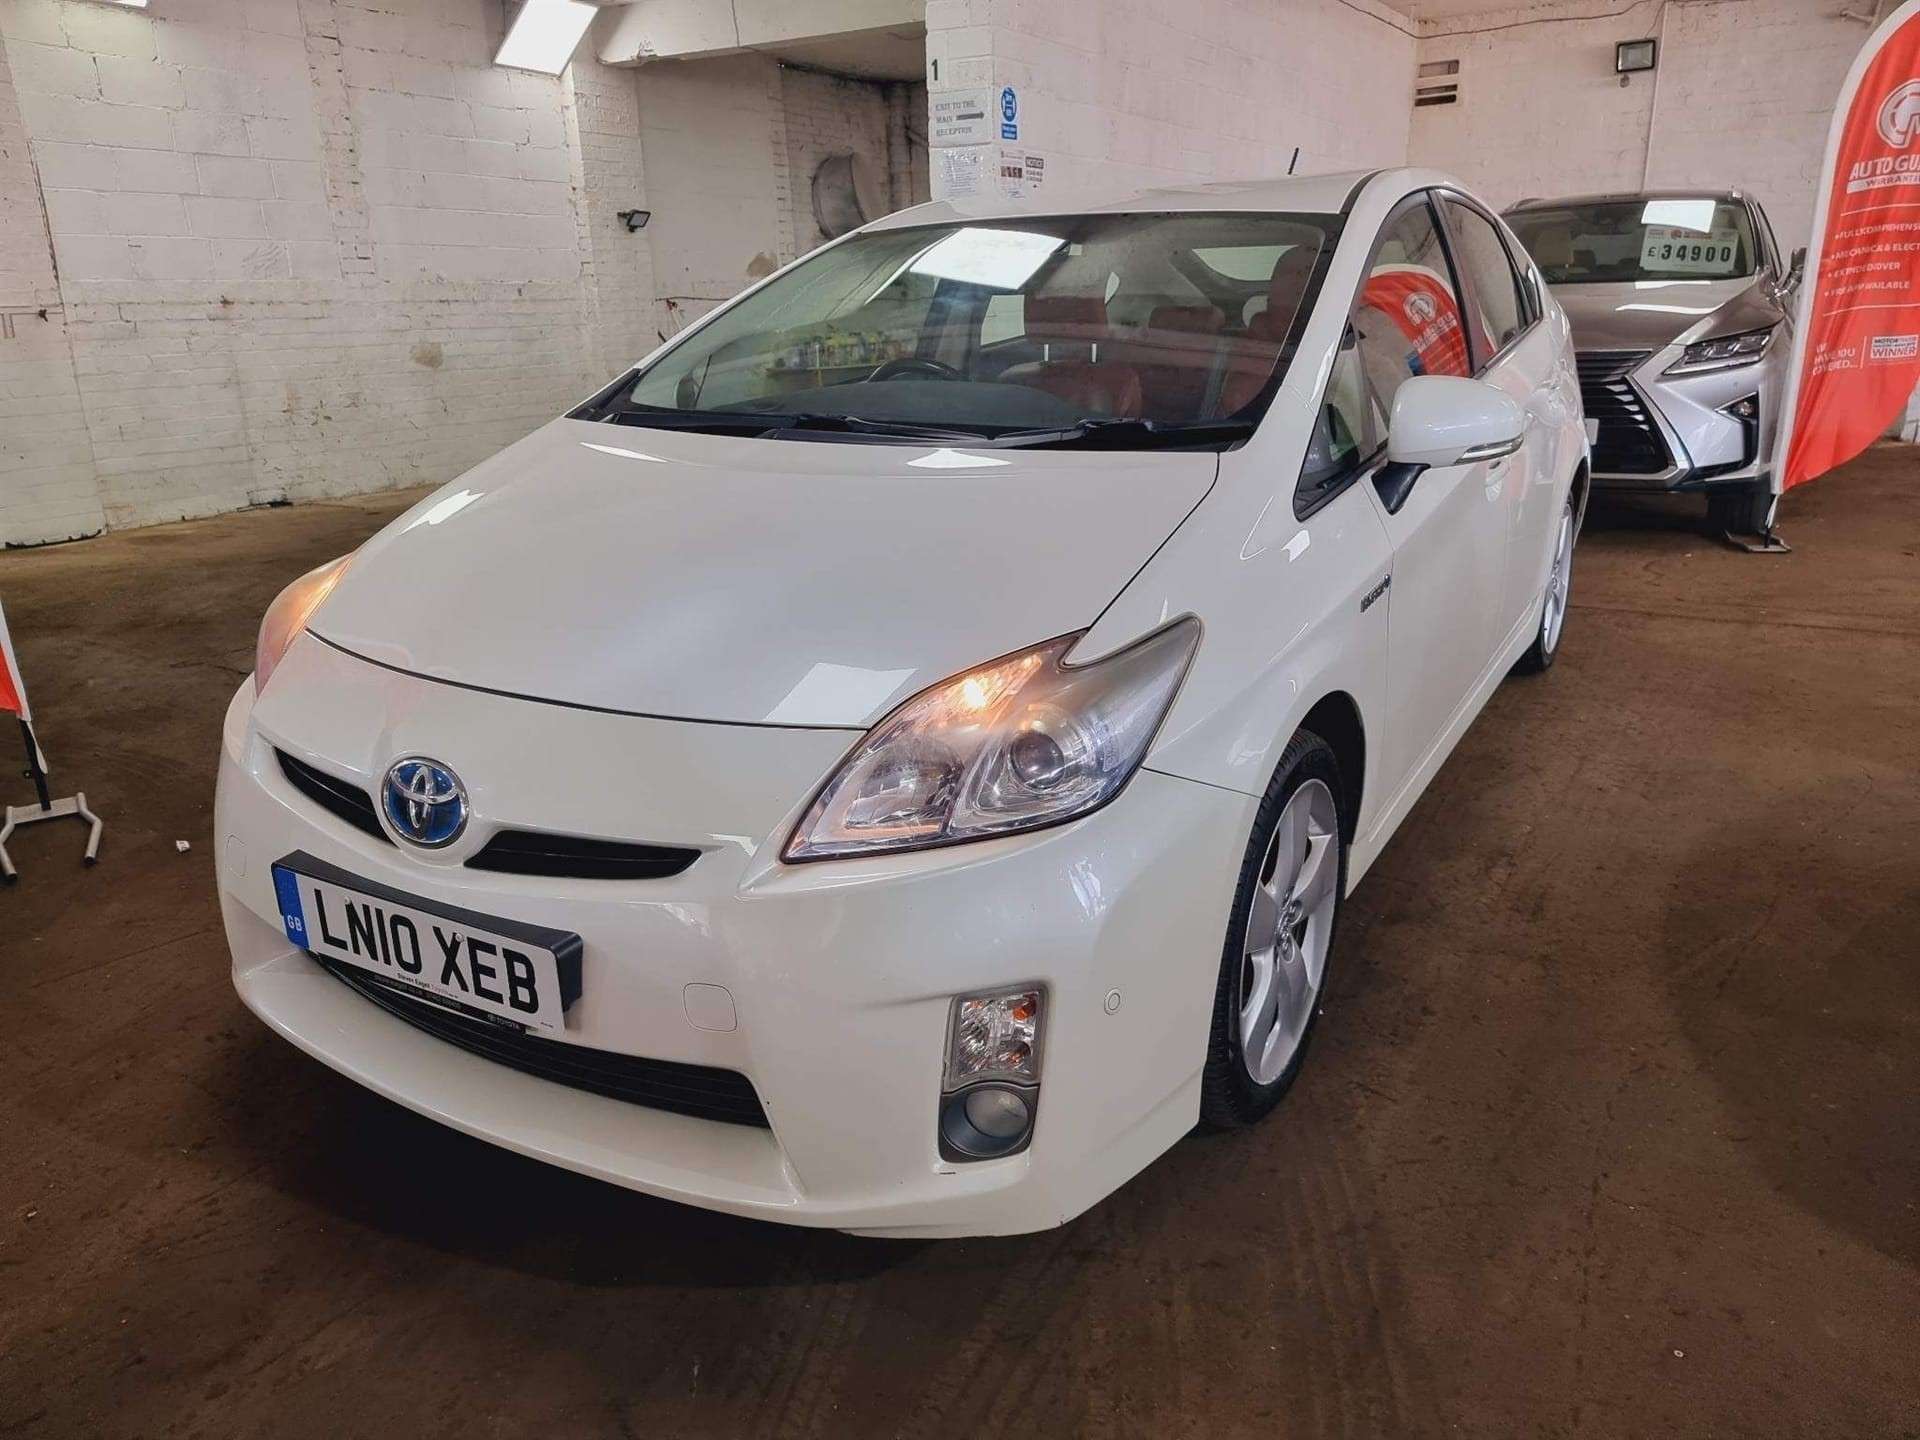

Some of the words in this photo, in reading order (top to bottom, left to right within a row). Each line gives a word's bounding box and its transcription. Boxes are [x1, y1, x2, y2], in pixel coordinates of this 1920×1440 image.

[931, 58, 938, 81] 1
[1873, 346, 1916, 357] WINNER
[287, 914, 303, 932] GB
[314, 888, 423, 974] LN10
[432, 925, 540, 1014] XEB
